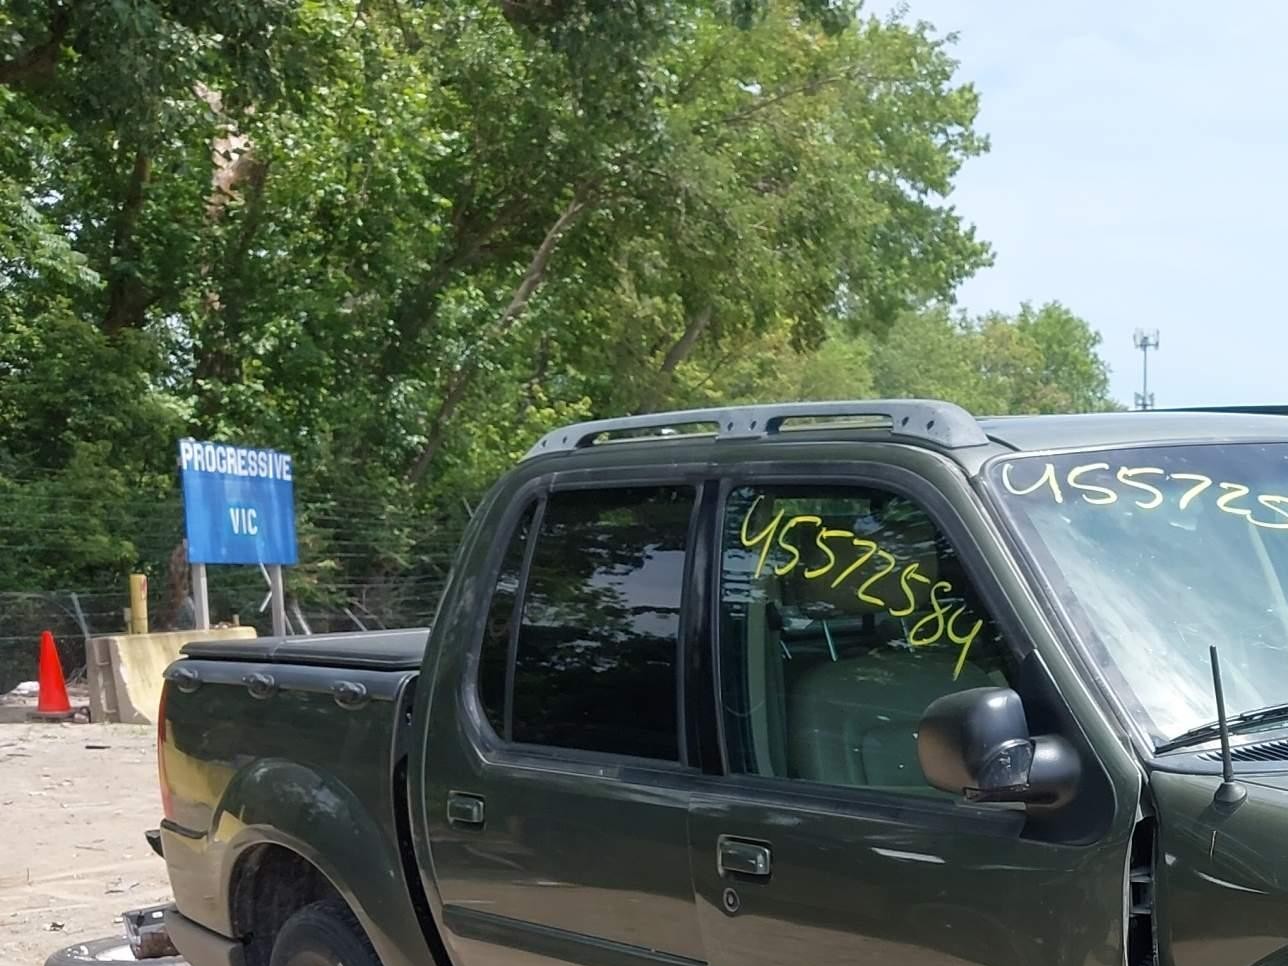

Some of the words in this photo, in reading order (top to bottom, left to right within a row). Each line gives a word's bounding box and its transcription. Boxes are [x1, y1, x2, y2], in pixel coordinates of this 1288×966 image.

[181, 442, 291, 481] PROGRESSIVE
[230, 508, 257, 535] VIC
[741, 495, 983, 681] 45572584
